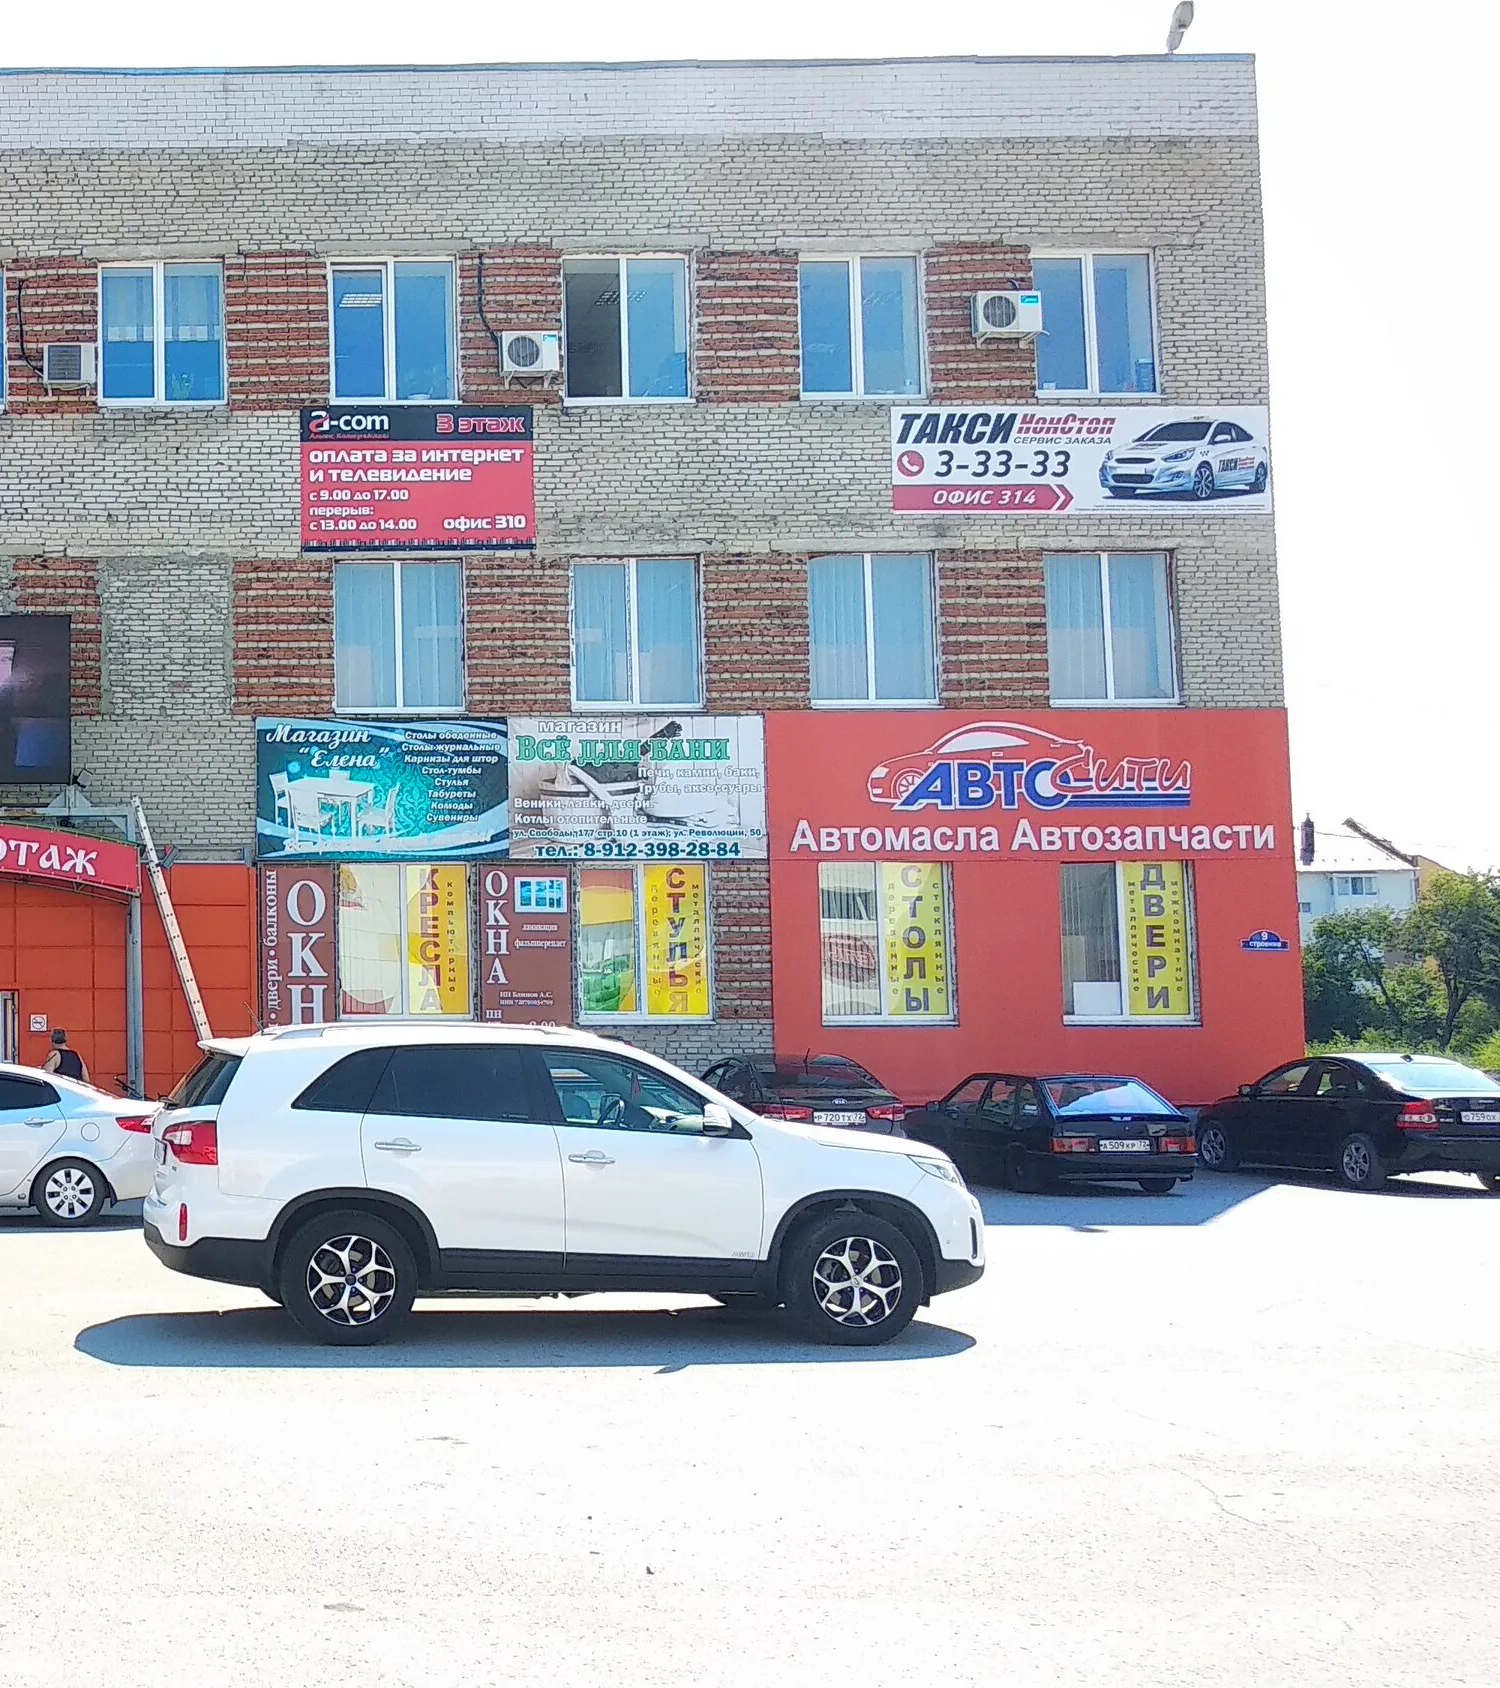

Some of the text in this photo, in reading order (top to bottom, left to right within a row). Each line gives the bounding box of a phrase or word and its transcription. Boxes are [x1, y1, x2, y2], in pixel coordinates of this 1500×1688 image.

[437, 414, 525, 433] 3 этаж
[897, 413, 1018, 444] ТАКСИ
[309, 449, 524, 465] оплата за интернет
[934, 451, 1071, 477] 3-33-33
[309, 468, 471, 482] и телевидение
[309, 489, 409, 501] с 9.00 до 17.00
[932, 490, 1036, 505] ОФИС 314
[309, 506, 374, 516] перерыв:
[309, 519, 417, 531] с 13.00 до 14.00
[443, 515, 526, 531] офис 310
[538, 721, 622, 733] магазин
[266, 723, 371, 749] Магазин
[404, 755, 450, 763] Карнизы
[638, 765, 759, 779] Печи, камни, баки,
[435, 778, 469, 787] Стулья
[638, 782, 761, 794] Трубы, аксессуары
[428, 789, 476, 798] Табуреты
[431, 802, 473, 810] Комоды
[427, 814, 478, 822] Сувениры
[514, 814, 648, 824] Котлы отопительные
[790, 818, 1275, 853] Автомасла Автозапчасти
[584, 842, 740, 856] 8-912-398-28-84
[263, 870, 278, 947] балконы
[485, 870, 509, 985] ОКНА
[419, 868, 443, 1010] КРЕСЛА
[666, 868, 688, 1012] СТУЛЬЯ
[901, 865, 929, 1012] СТОЛЫ
[932, 882, 944, 994] стеклянные
[1140, 864, 1169, 1009] ДВЕРИ
[1261, 932, 1268, 940] 9
[286, 880, 328, 1024] ОКН
[268, 959, 282, 1010] двери
